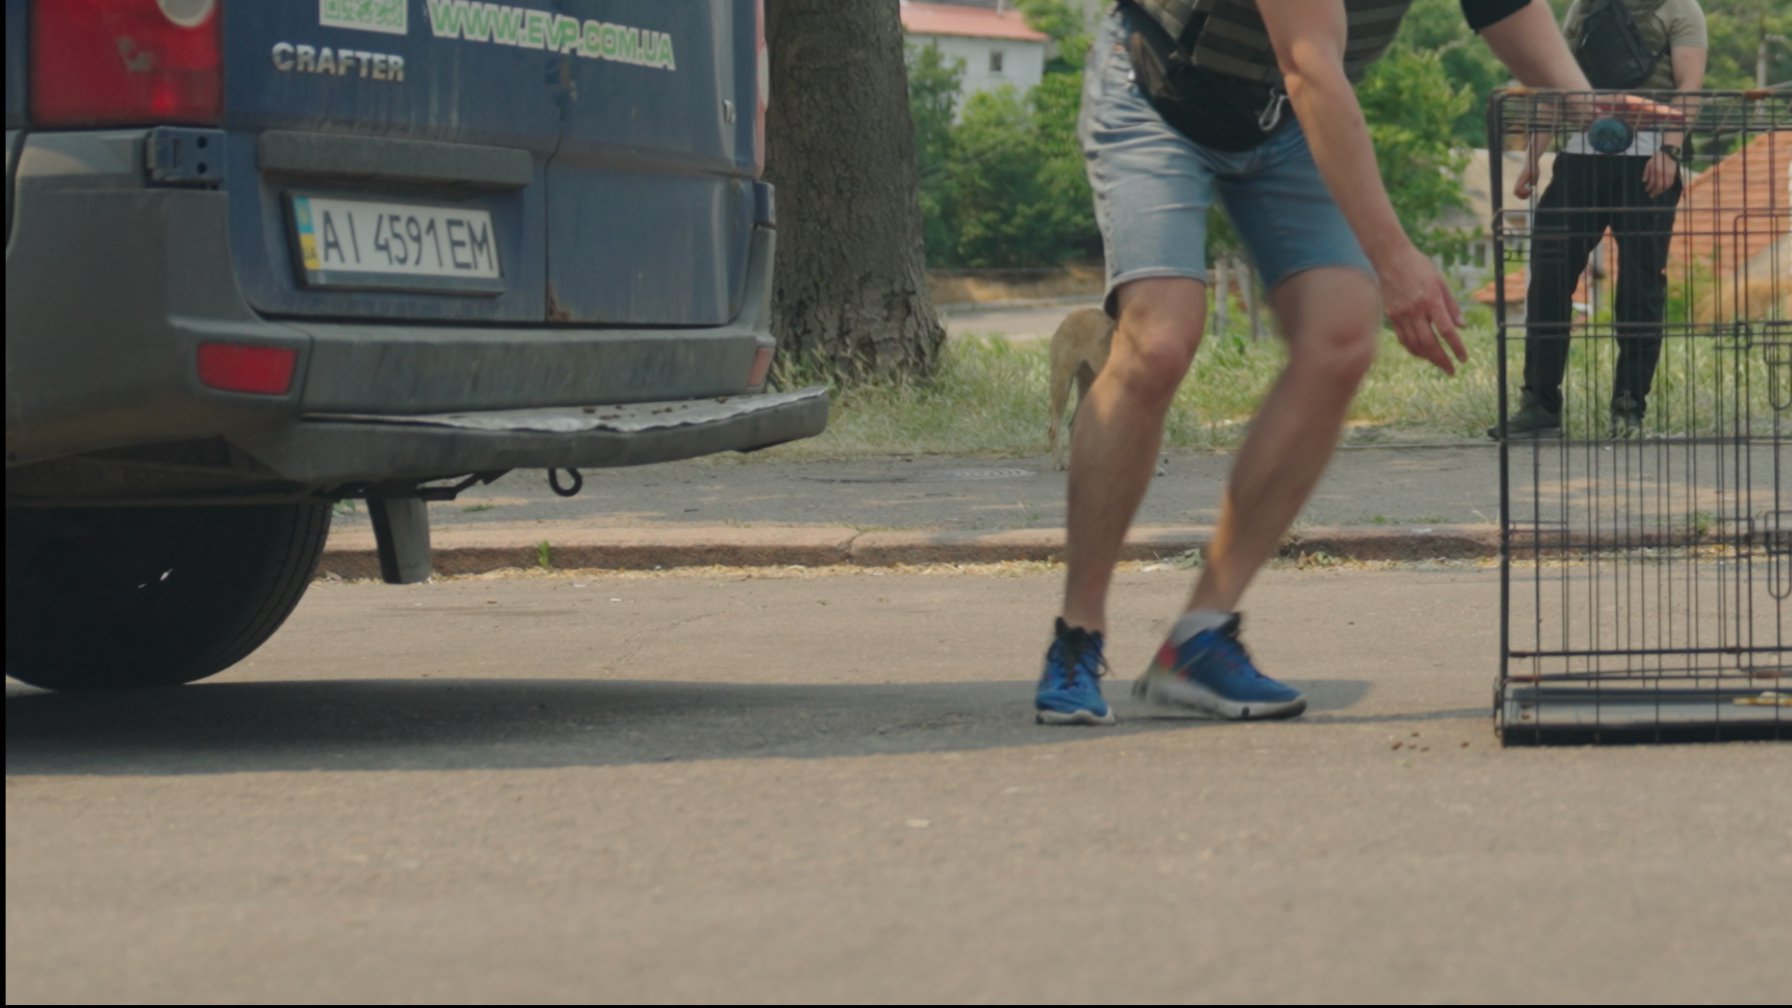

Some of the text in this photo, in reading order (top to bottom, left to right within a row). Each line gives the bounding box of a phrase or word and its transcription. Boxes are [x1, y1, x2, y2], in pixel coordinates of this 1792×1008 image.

[272, 42, 405, 82] CRAFTER
[323, 209, 494, 271] AI 4591 EM
